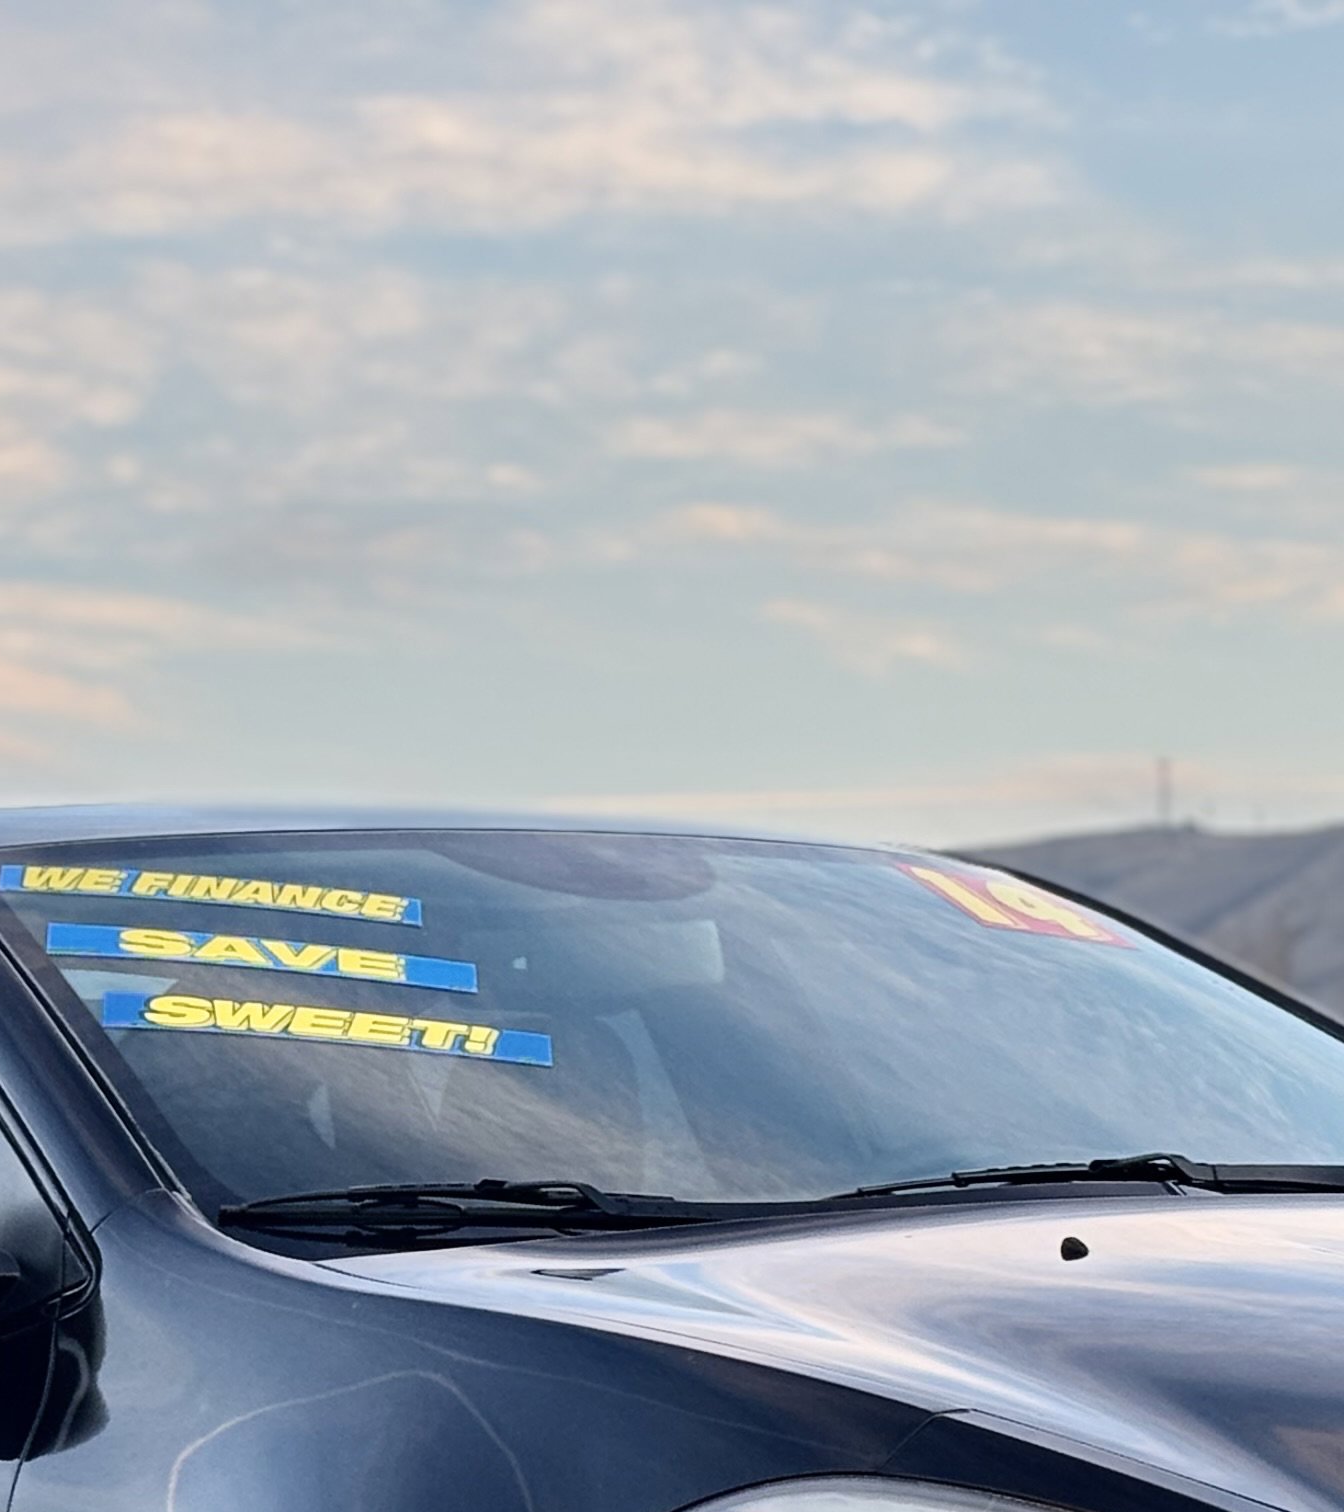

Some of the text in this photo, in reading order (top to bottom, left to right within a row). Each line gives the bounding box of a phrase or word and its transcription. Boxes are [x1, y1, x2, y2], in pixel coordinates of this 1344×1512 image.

[22, 865, 410, 921] WE FINANCE
[906, 864, 1113, 942] 14
[118, 928, 406, 980] SAVE
[140, 994, 499, 1055] SWEET!
